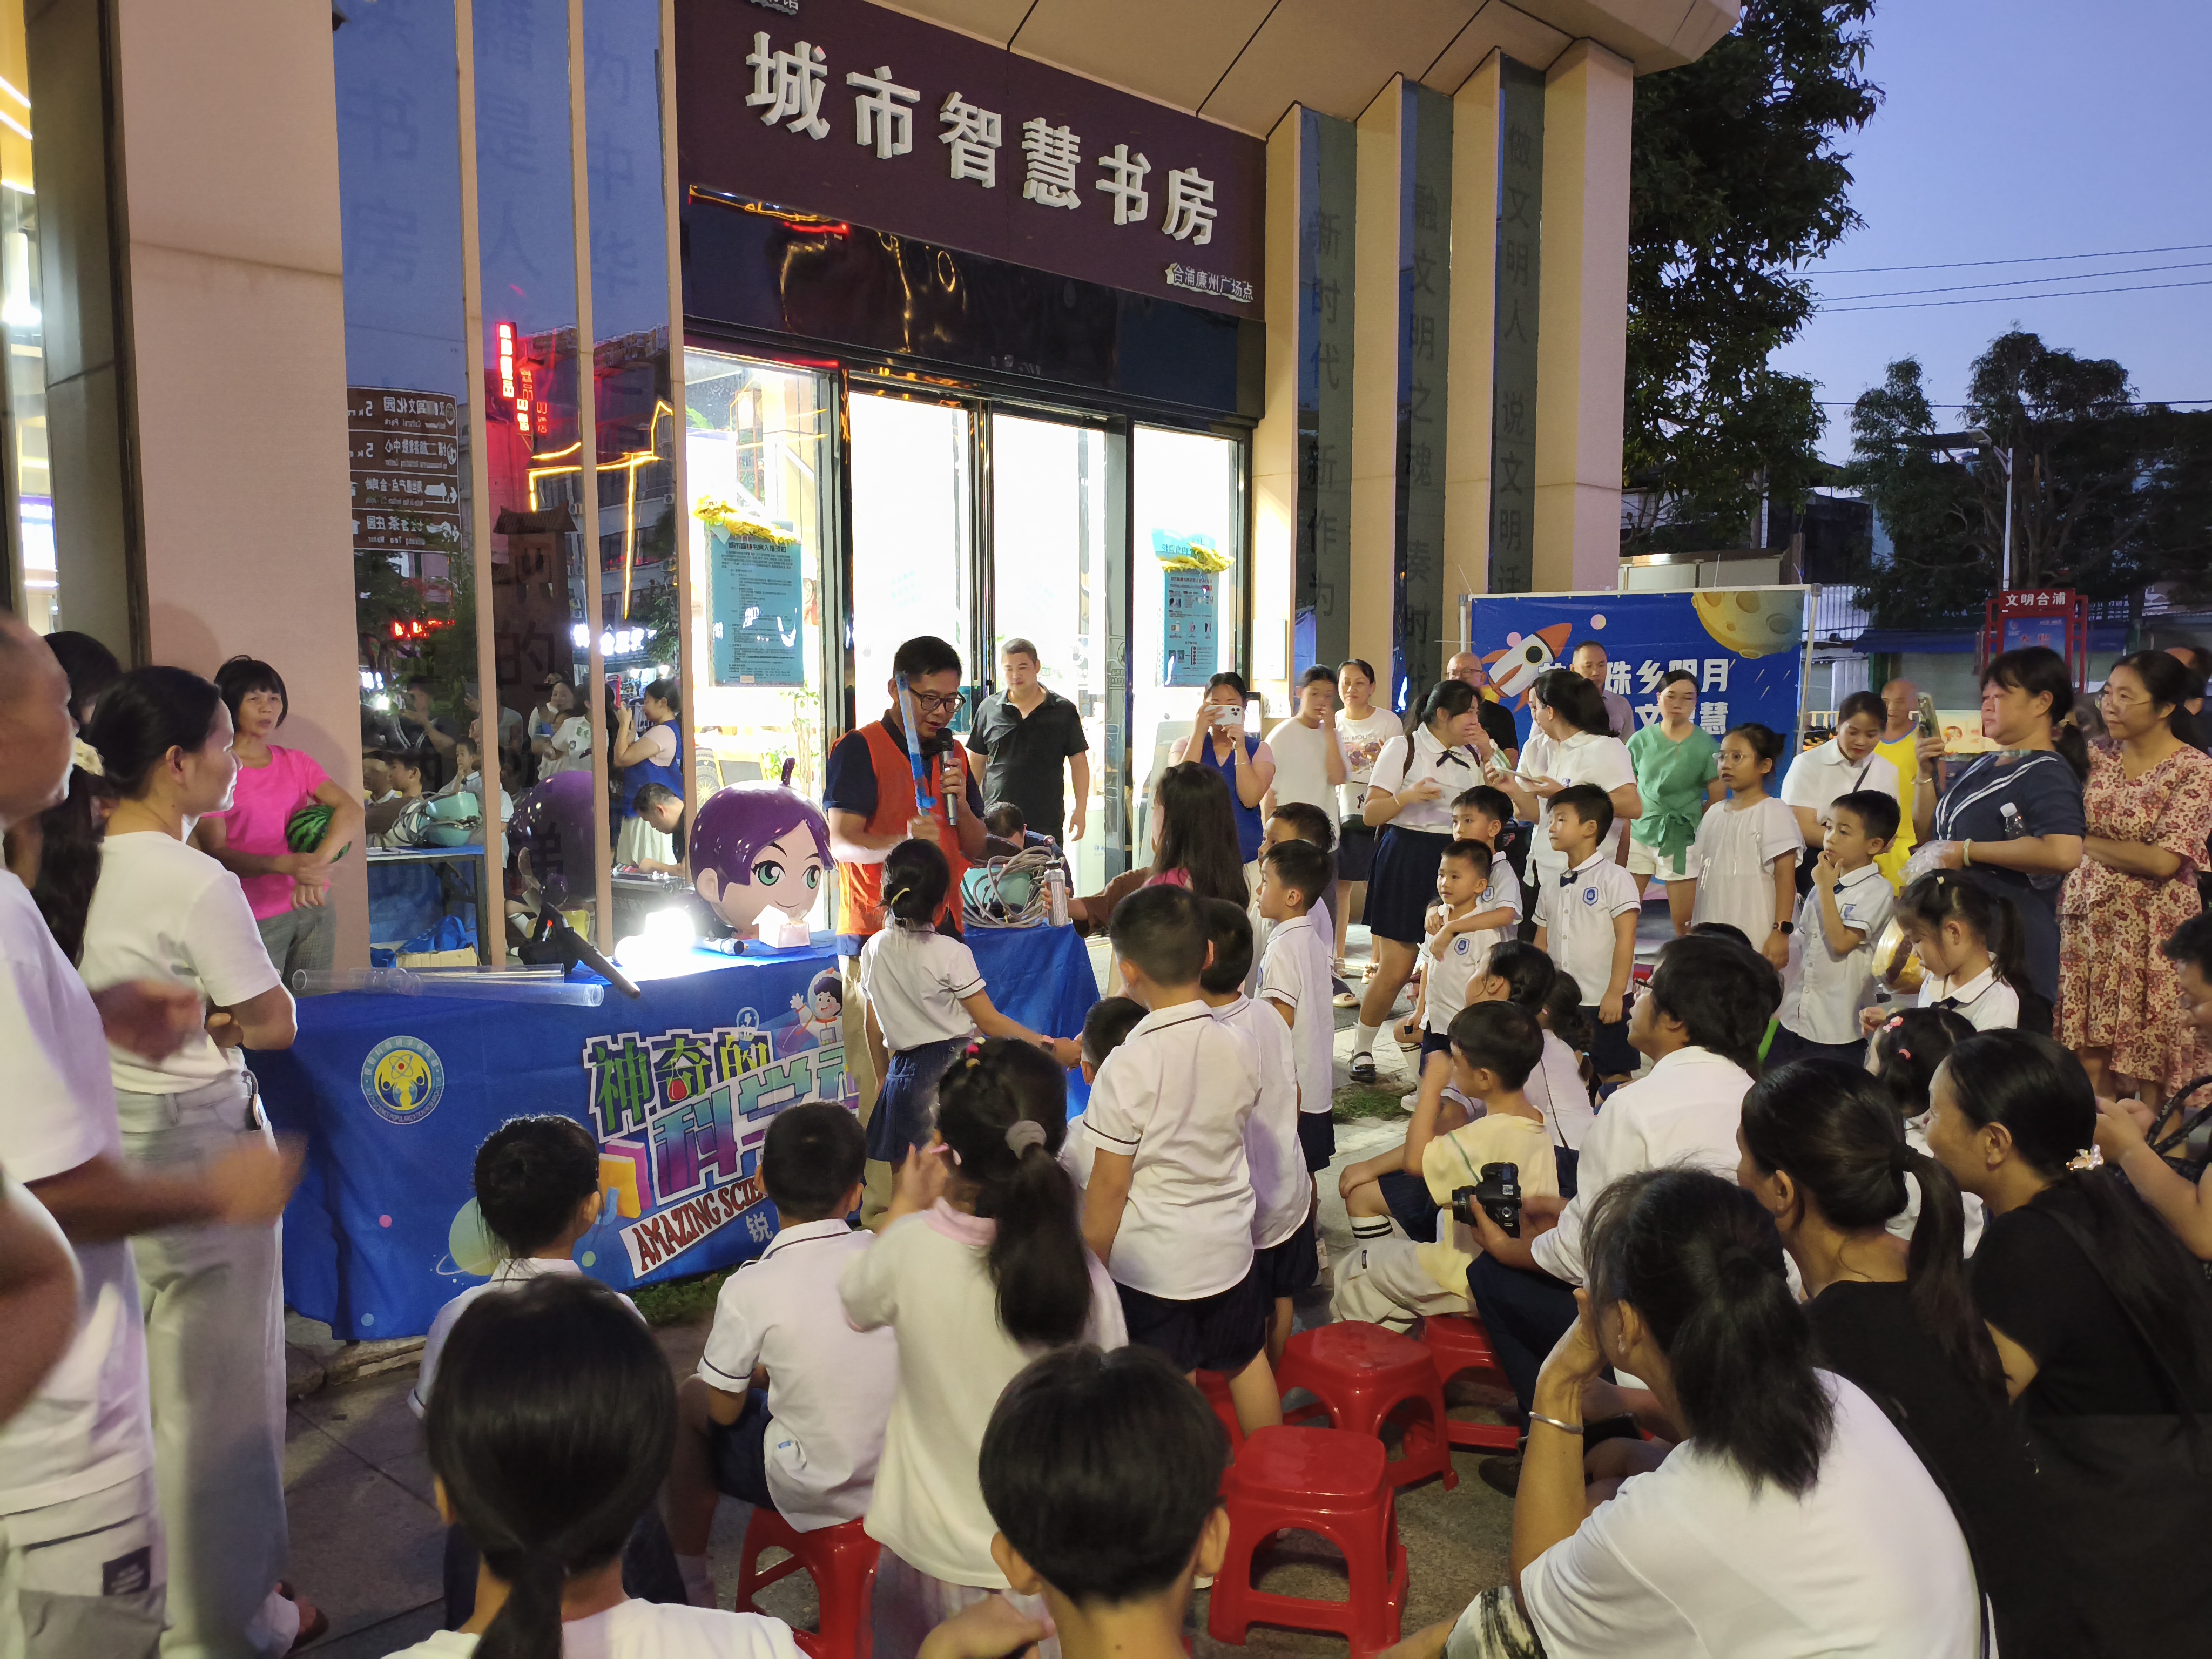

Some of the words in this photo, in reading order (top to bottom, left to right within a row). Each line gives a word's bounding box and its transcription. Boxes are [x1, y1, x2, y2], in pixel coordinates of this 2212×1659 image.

[746, 31, 1217, 245] 城市智慧书房
[1172, 264, 1254, 301] 合浦廉州广场点
[2005, 592, 2066, 606] 文明合浦
[1351, 732, 1377, 741] MOUSE
[590, 1033, 770, 1134] 神奇的
[631, 1192, 722, 1272] AMAZING
[717, 1177, 765, 1218] SCIE
